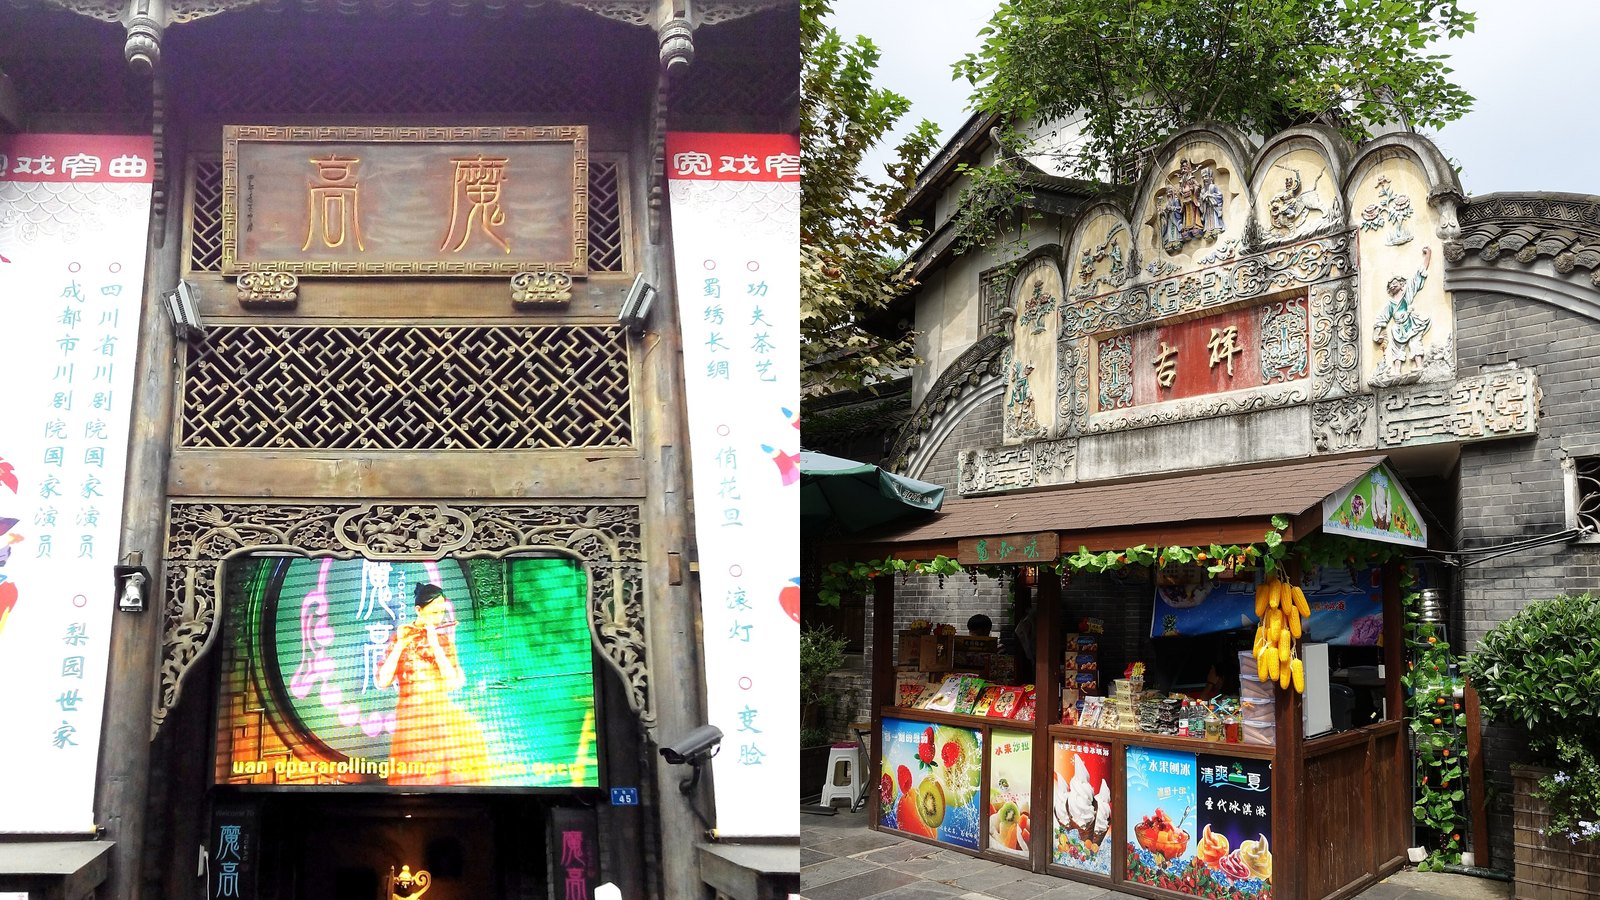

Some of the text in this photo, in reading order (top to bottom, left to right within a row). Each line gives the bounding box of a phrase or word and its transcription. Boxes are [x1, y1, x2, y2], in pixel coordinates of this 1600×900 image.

[703, 277, 730, 381] 蜀绣长绸
[747, 281, 777, 382] 功夫茶艺
[1153, 325, 1243, 389] 吉祥
[714, 447, 741, 527] 俏花旦
[725, 587, 753, 643] 滚灯
[52, 622, 90, 749] 梨园世家
[737, 704, 767, 766] 变脸
[618, 795, 632, 803] 45
[1148, 759, 1191, 777] 水果刨冰
